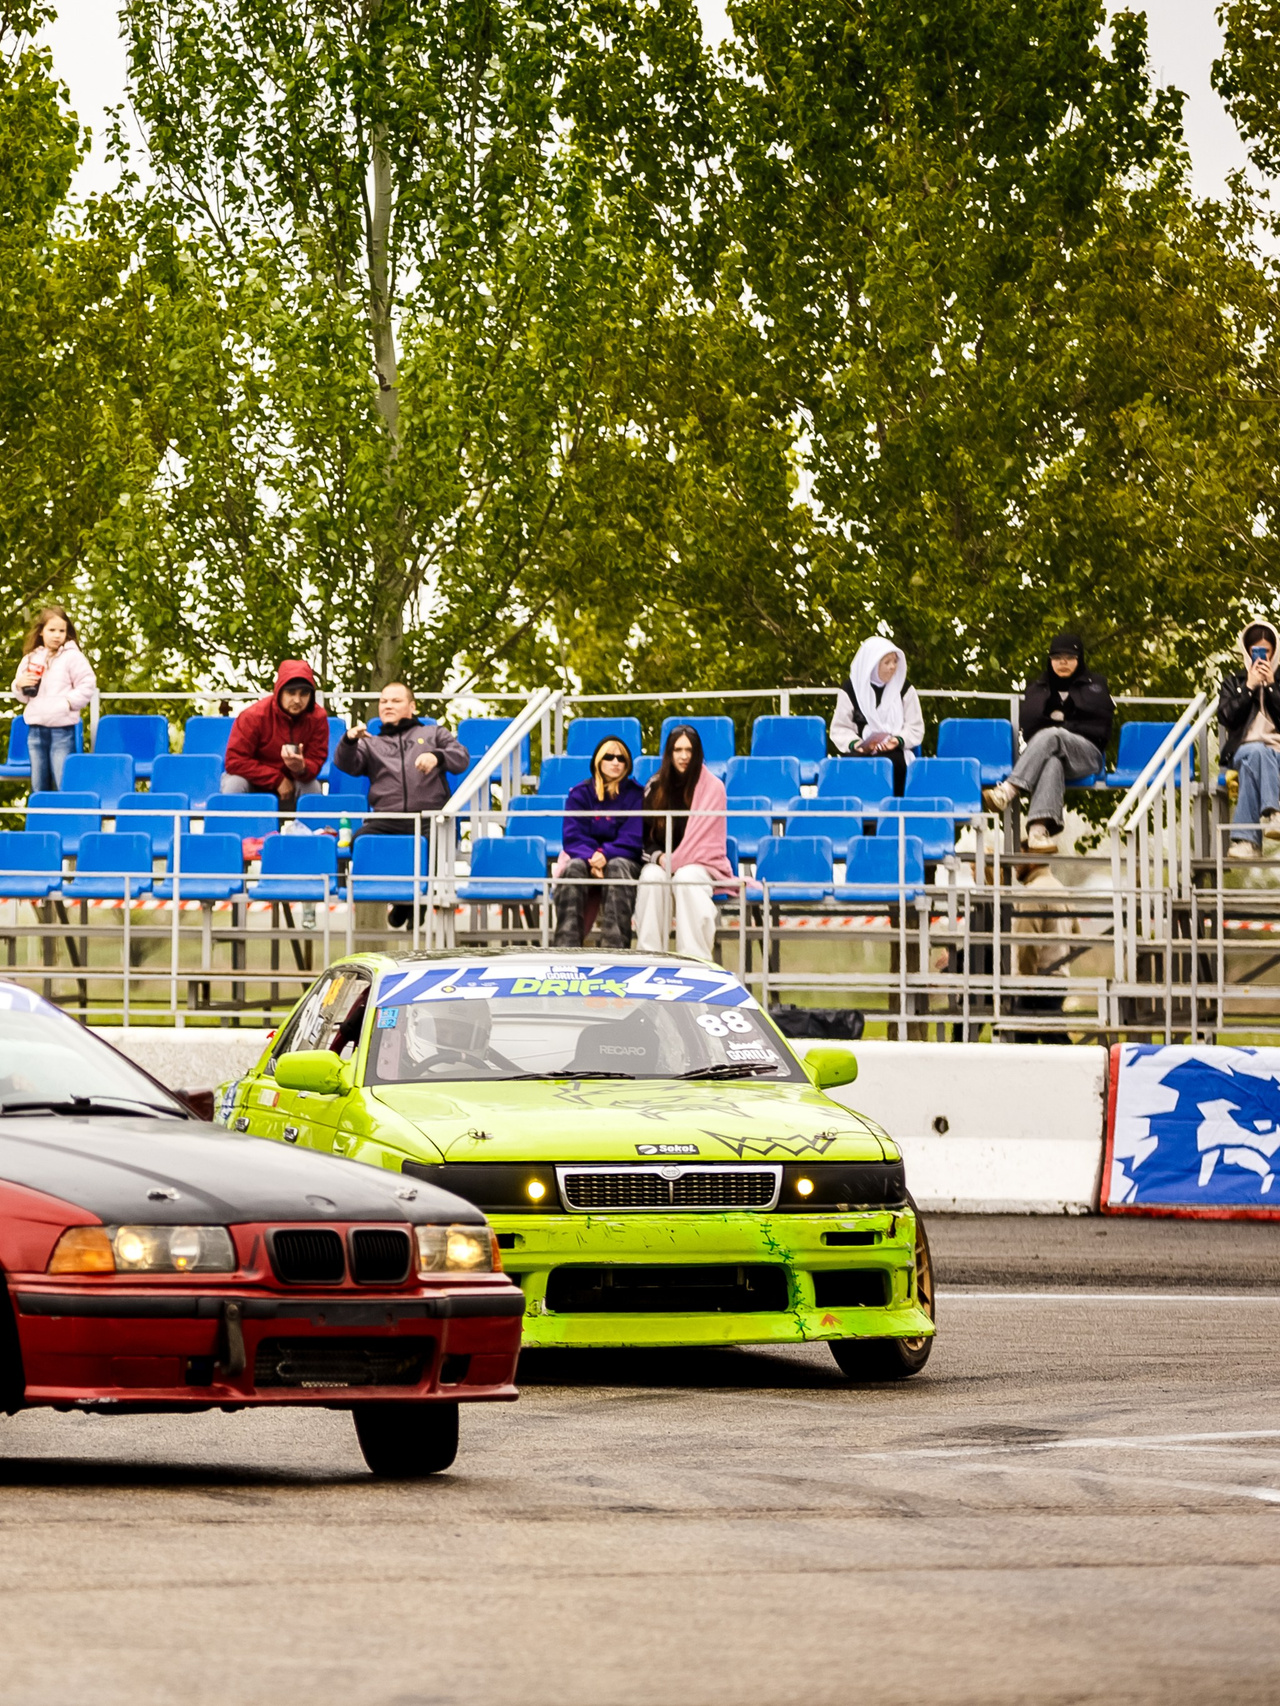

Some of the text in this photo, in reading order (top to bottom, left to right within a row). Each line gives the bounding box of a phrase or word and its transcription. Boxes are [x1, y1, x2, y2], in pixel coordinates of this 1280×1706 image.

[546, 972, 587, 980] GORILLA
[696, 1010, 753, 1037] 88
[599, 1045, 646, 1056] RECARO
[726, 1049, 779, 1061] GORILLA
